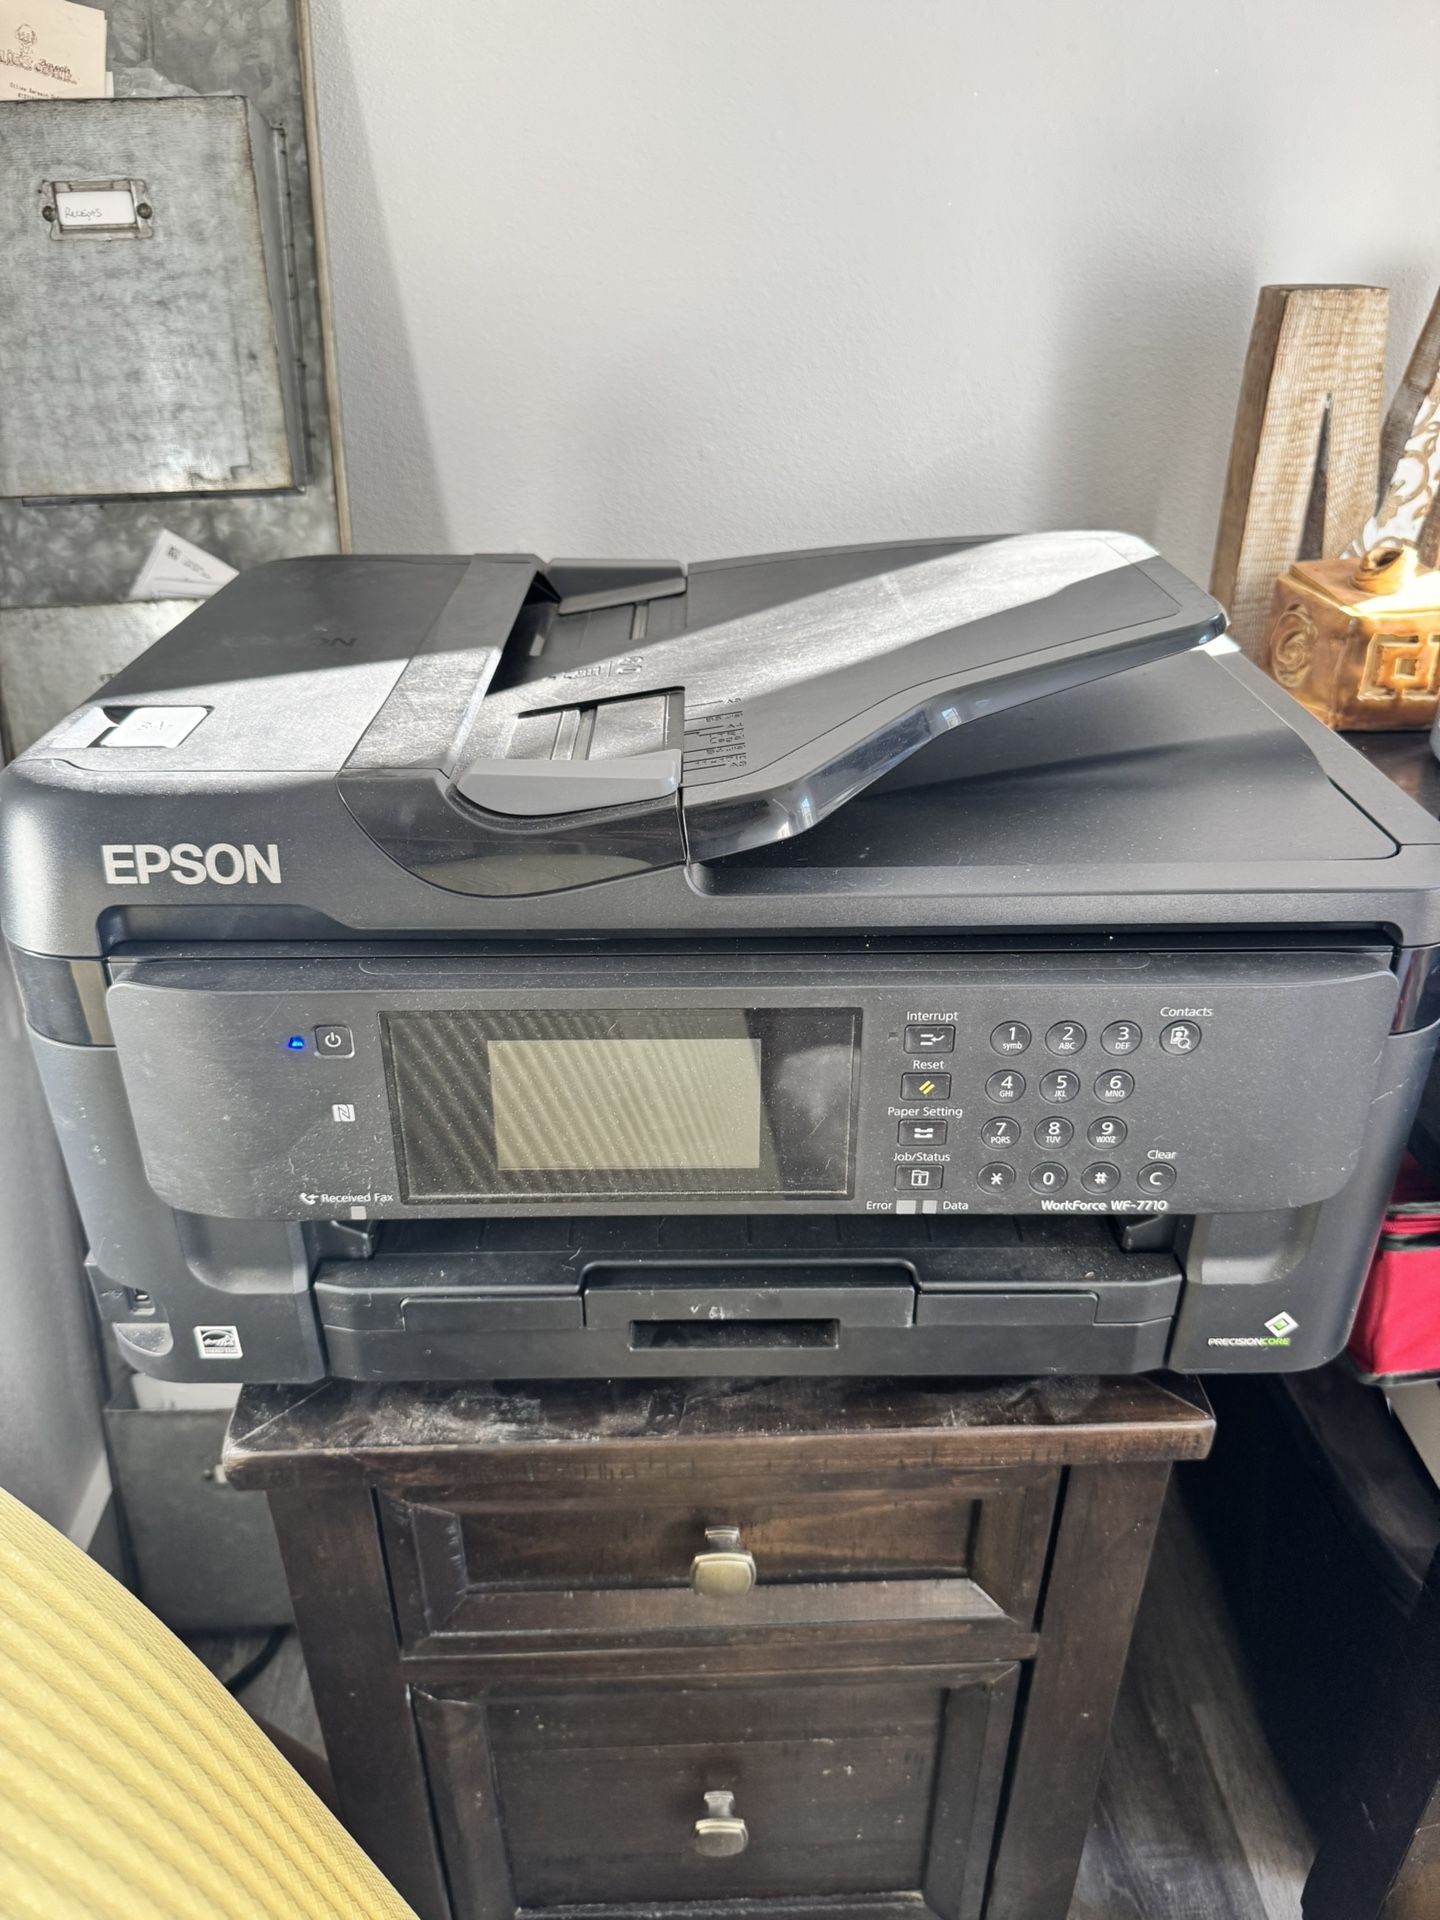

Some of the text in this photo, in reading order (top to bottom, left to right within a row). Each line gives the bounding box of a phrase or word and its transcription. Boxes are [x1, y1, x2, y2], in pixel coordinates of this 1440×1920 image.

[101, 843, 282, 885] EPSON
[906, 1011, 959, 1023] Interrupt
[1160, 1006, 1213, 1017] Contacts
[1008, 1026, 1017, 1041] 1
[1062, 1026, 1075, 1041] 2
[1117, 1026, 1130, 1041] 3
[1002, 1042, 1023, 1051] symb
[1058, 1042, 1076, 1050] ABC
[1115, 1042, 1131, 1050] DEF
[913, 1060, 945, 1070] Reset
[1001, 1075, 1014, 1089] 4
[1056, 1075, 1068, 1089] 5
[1109, 1075, 1122, 1089] 6
[999, 1090, 1014, 1098] GHI
[1054, 1090, 1067, 1098] JKL
[1105, 1090, 1125, 1098] MNO
[887, 1107, 963, 1118] Paper Setting
[996, 1122, 1007, 1135] 7
[1048, 1122, 1060, 1135] 8
[1101, 1122, 1114, 1135] 9
[990, 1136, 1010, 1144] PQRS
[1045, 1136, 1061, 1144] TUV
[1096, 1136, 1116, 1144] WXYZ
[893, 1152, 951, 1162] Job/Status
[1147, 1150, 1176, 1160] Clear
[1094, 1171, 1108, 1184] #
[1149, 1172, 1163, 1186] C
[321, 1193, 394, 1203] Received Fax
[866, 1201, 893, 1210] Error
[943, 1201, 969, 1210] Data
[1041, 1200, 1168, 1211] WorkForce WF-7710
